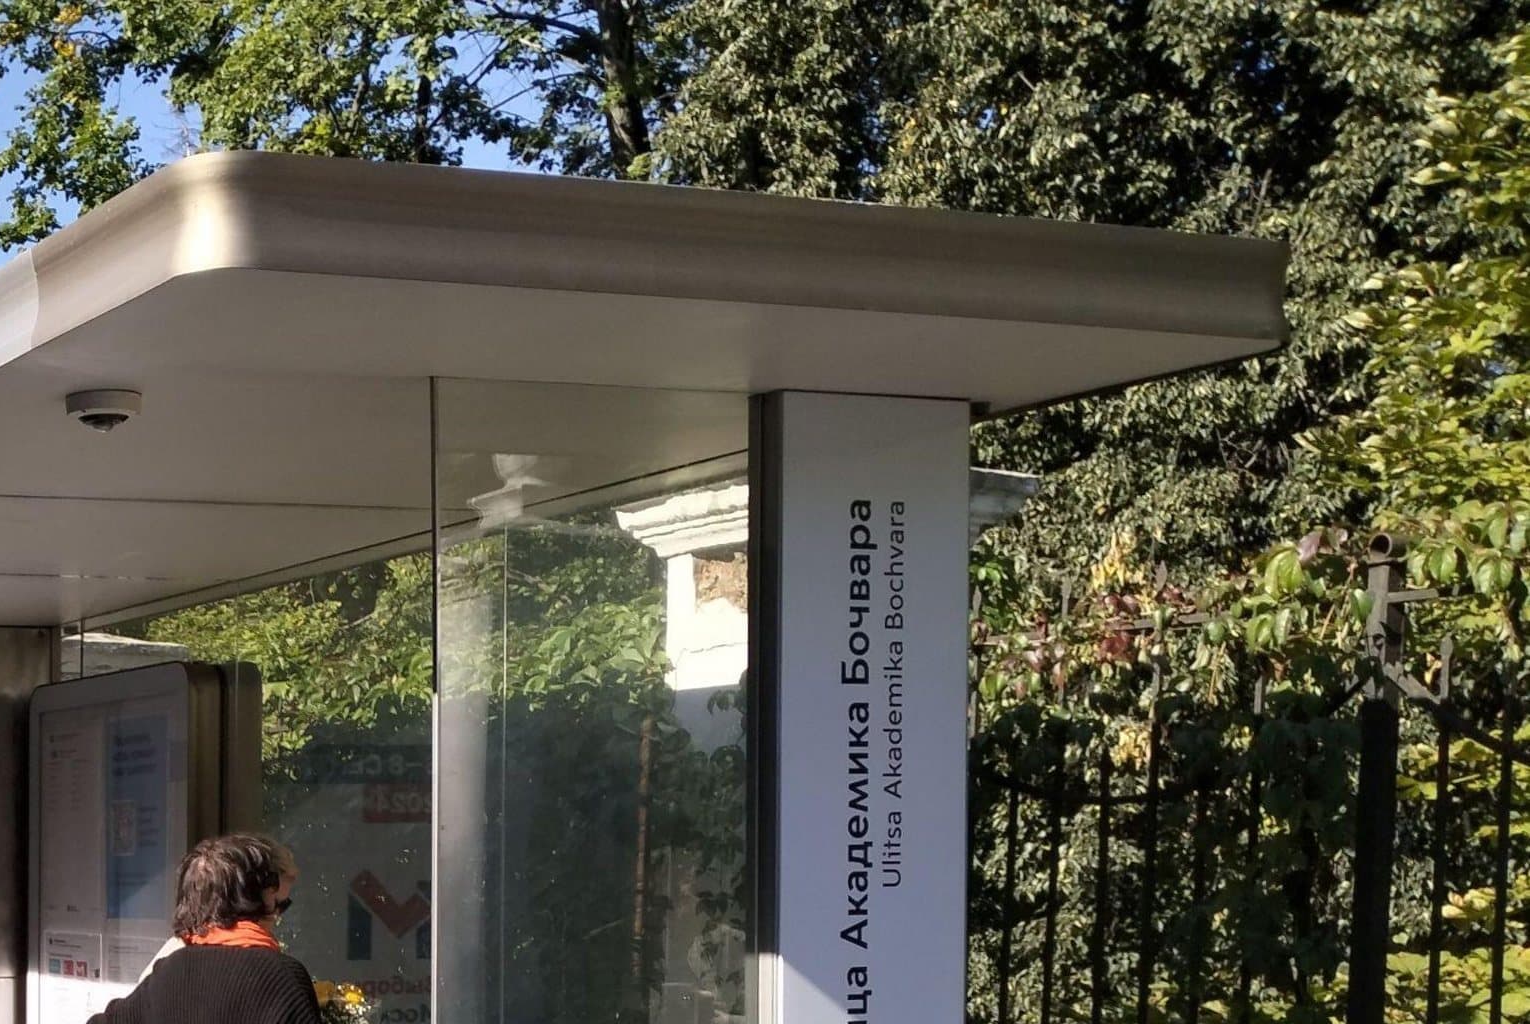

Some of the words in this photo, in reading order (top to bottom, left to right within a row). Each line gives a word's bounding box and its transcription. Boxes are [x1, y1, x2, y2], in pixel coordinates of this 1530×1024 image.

[841, 499, 878, 685] Бочвара
[884, 501, 905, 630] Bochvara
[882, 641, 903, 799] Akademika
[839, 702, 873, 950] Академика
[882, 811, 902, 888] Ulitsa
